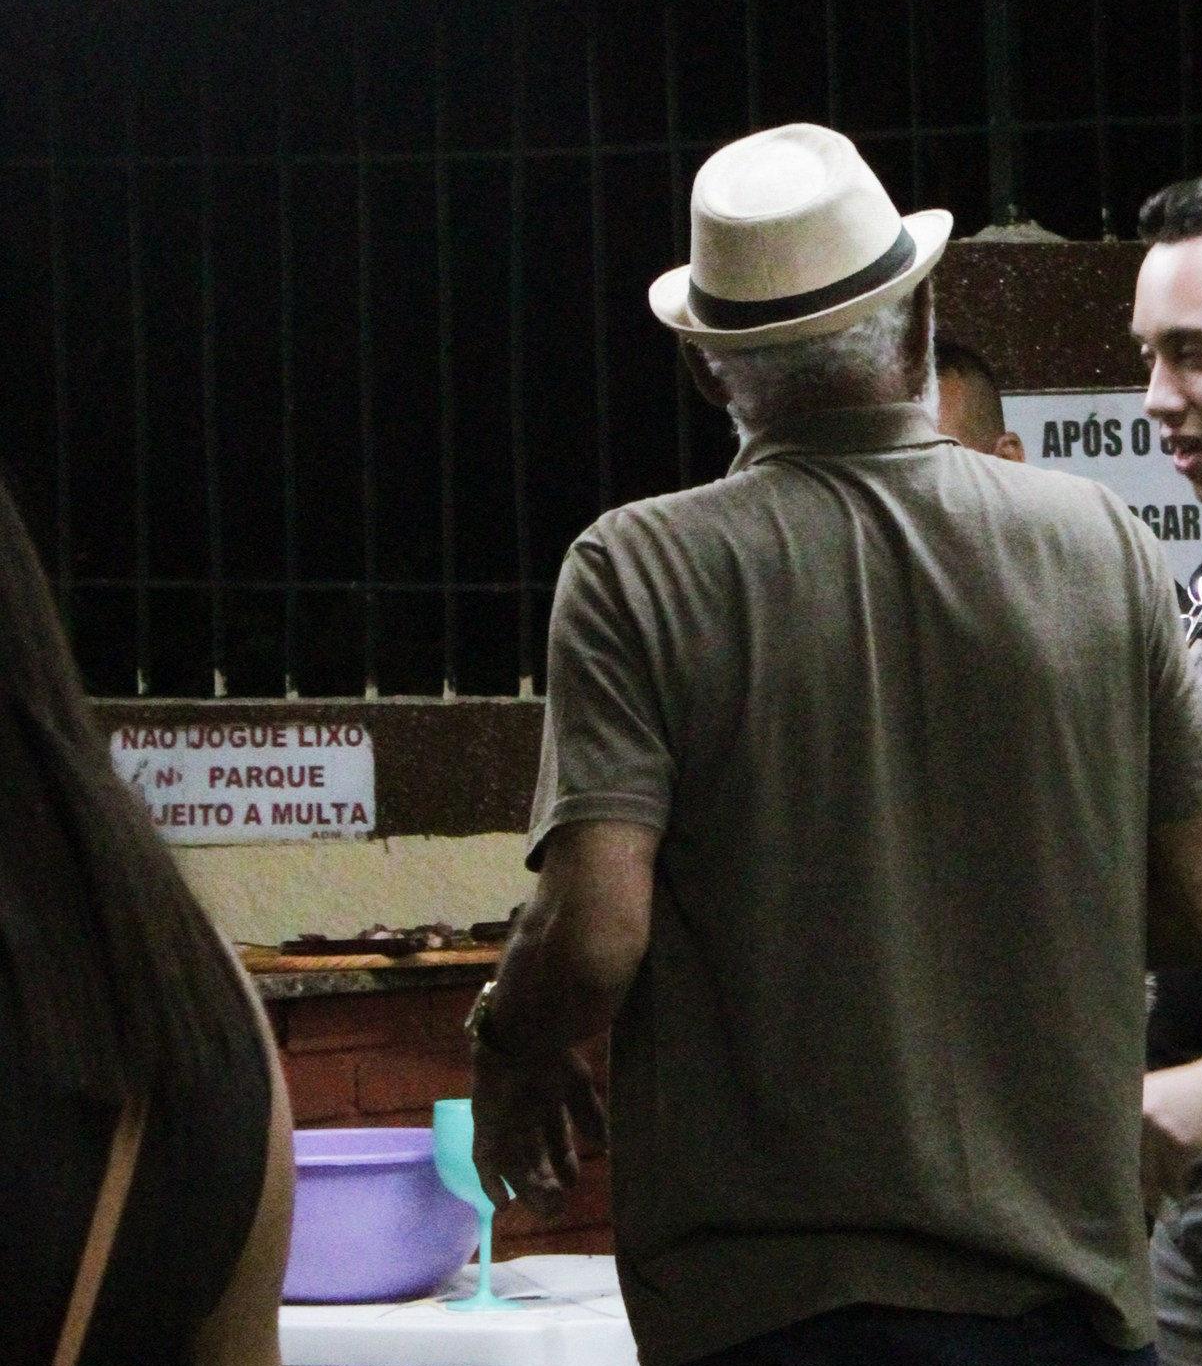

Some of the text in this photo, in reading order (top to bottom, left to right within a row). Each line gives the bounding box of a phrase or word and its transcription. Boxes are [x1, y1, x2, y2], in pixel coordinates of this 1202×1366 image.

[1042, 411, 1123, 458] APÓS
[1131, 418, 1151, 456] O
[186, 724, 287, 749] JOGUE
[298, 722, 363, 748] LIXO
[208, 765, 325, 789] PARQUE
[147, 801, 368, 827] JEITO A MULTA
